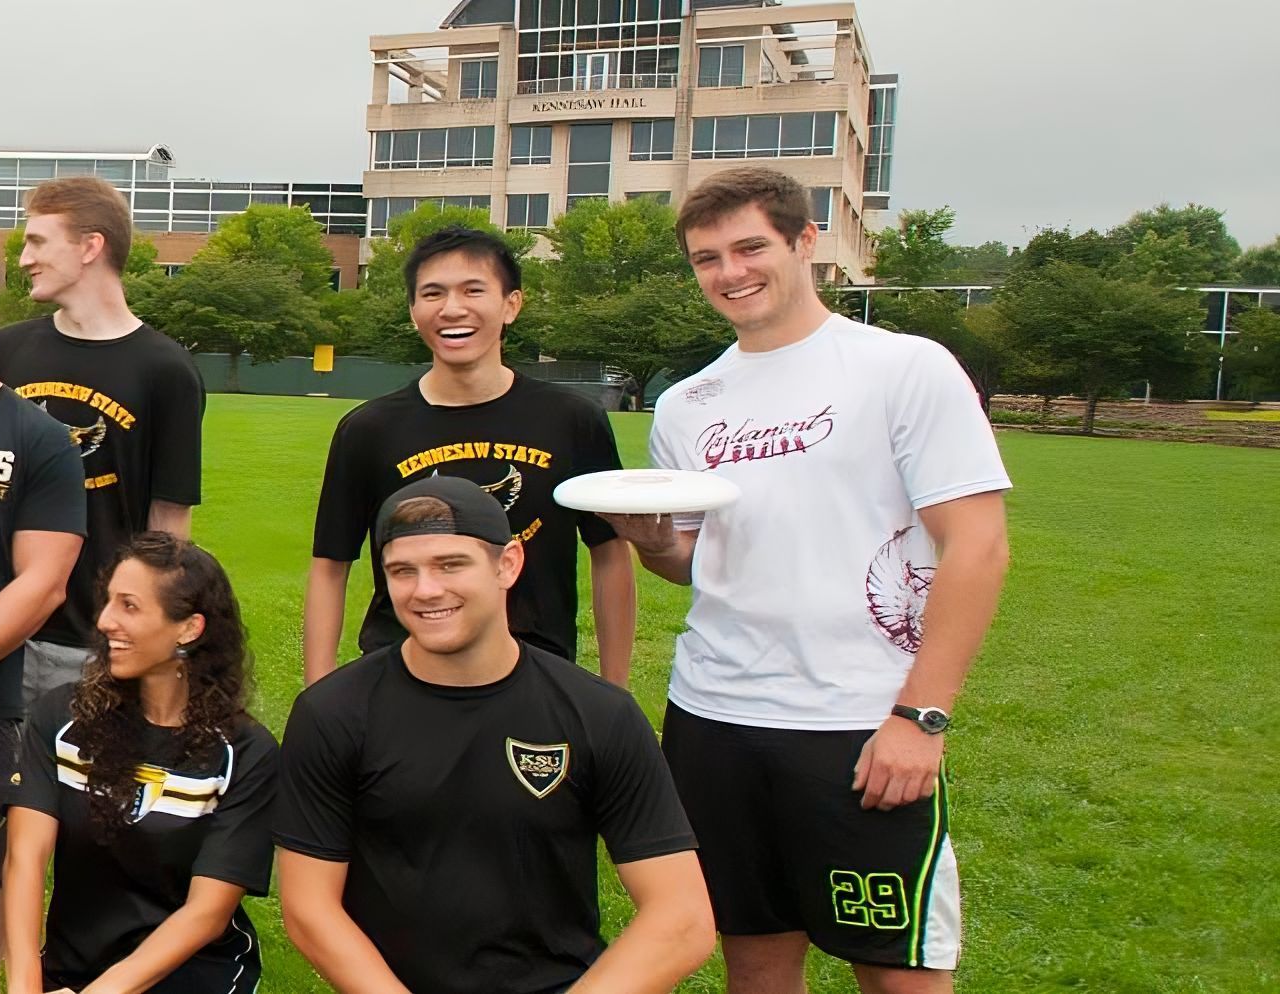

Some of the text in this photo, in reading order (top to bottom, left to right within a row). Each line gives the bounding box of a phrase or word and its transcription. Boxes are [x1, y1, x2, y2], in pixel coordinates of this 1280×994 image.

[532, 98, 647, 112] KENNESAW HALL
[89, 391, 137, 430] STATE
[396, 441, 553, 479] KENNESAW STATE
[830, 869, 910, 930] 29
